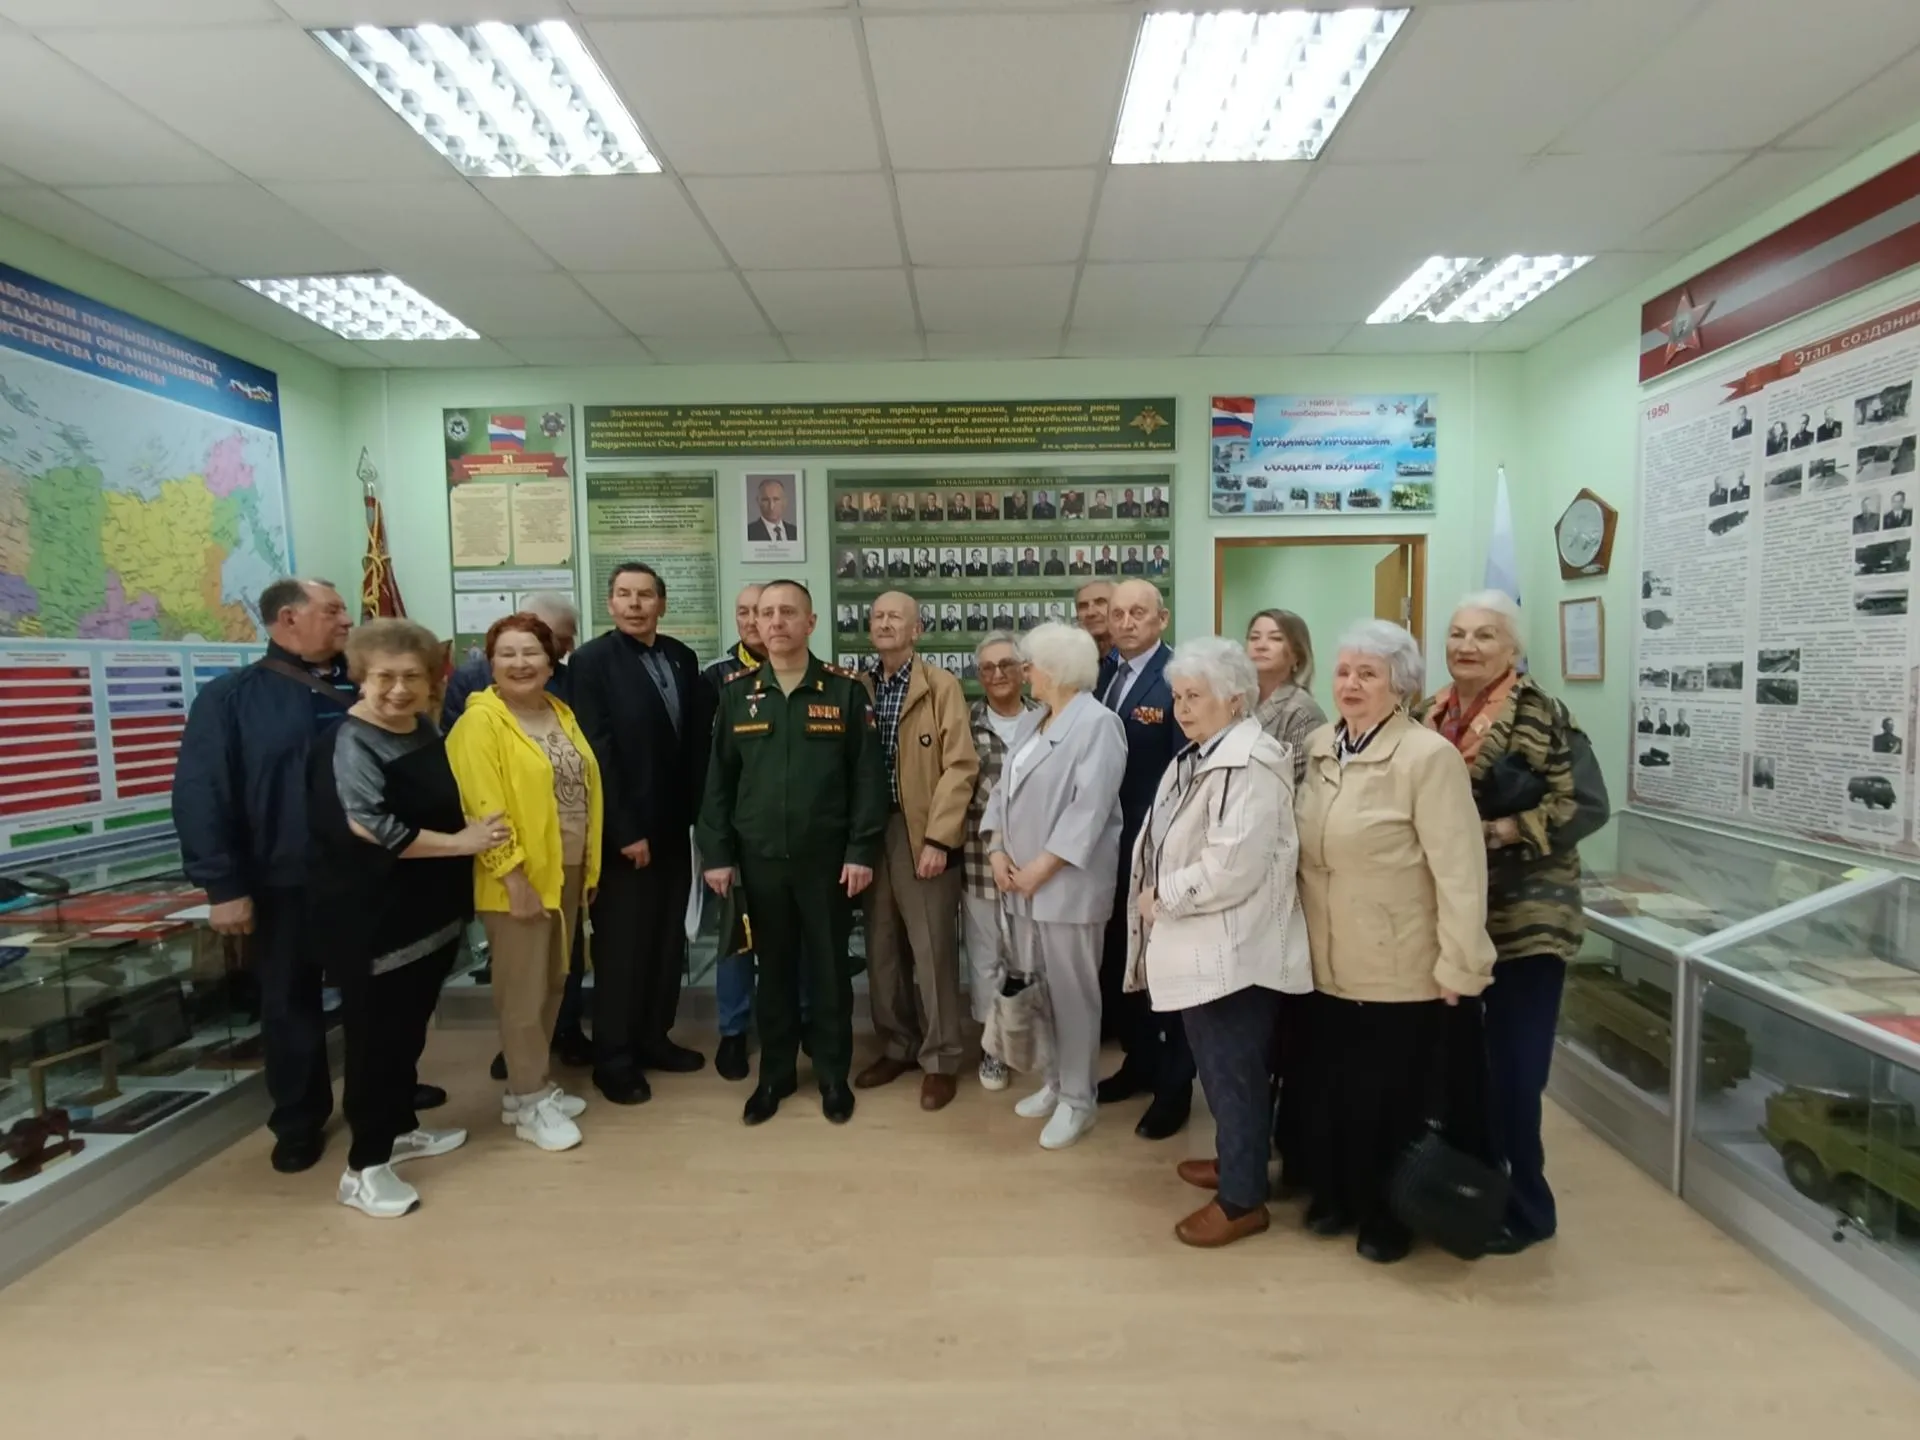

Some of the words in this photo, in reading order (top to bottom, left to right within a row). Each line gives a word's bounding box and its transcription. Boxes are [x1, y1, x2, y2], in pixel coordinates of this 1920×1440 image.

[1793, 343, 1832, 367] Этап
[96, 352, 167, 387] ОБОРОНЫ
[729, 408, 764, 417] начале
[771, 407, 815, 416] создания
[823, 407, 882, 416] института
[1089, 403, 1121, 414] роста
[1645, 402, 1670, 421] 1950
[781, 416, 849, 427] исследований,
[852, 415, 916, 427] преданности
[918, 415, 969, 426] служению
[971, 414, 1010, 424] военной
[1012, 413, 1089, 424] автомобильной
[590, 429, 642, 439] составили
[643, 428, 688, 438] основной
[689, 427, 746, 440] фундамент
[747, 427, 794, 438] успешной
[796, 426, 866, 437] деятельности
[868, 426, 927, 437] института
[936, 427, 952, 436] его
[953, 425, 998, 435] большого
[999, 424, 1034, 434] вклада
[1043, 424, 1121, 434] строительство
[657, 440, 679, 449] Сил,
[740, 438, 796, 448] важнейшей
[796, 437, 870, 448] составляющей
[877, 436, 915, 446] военной
[916, 435, 992, 445] автомобильной
[993, 436, 1039, 445] техники.
